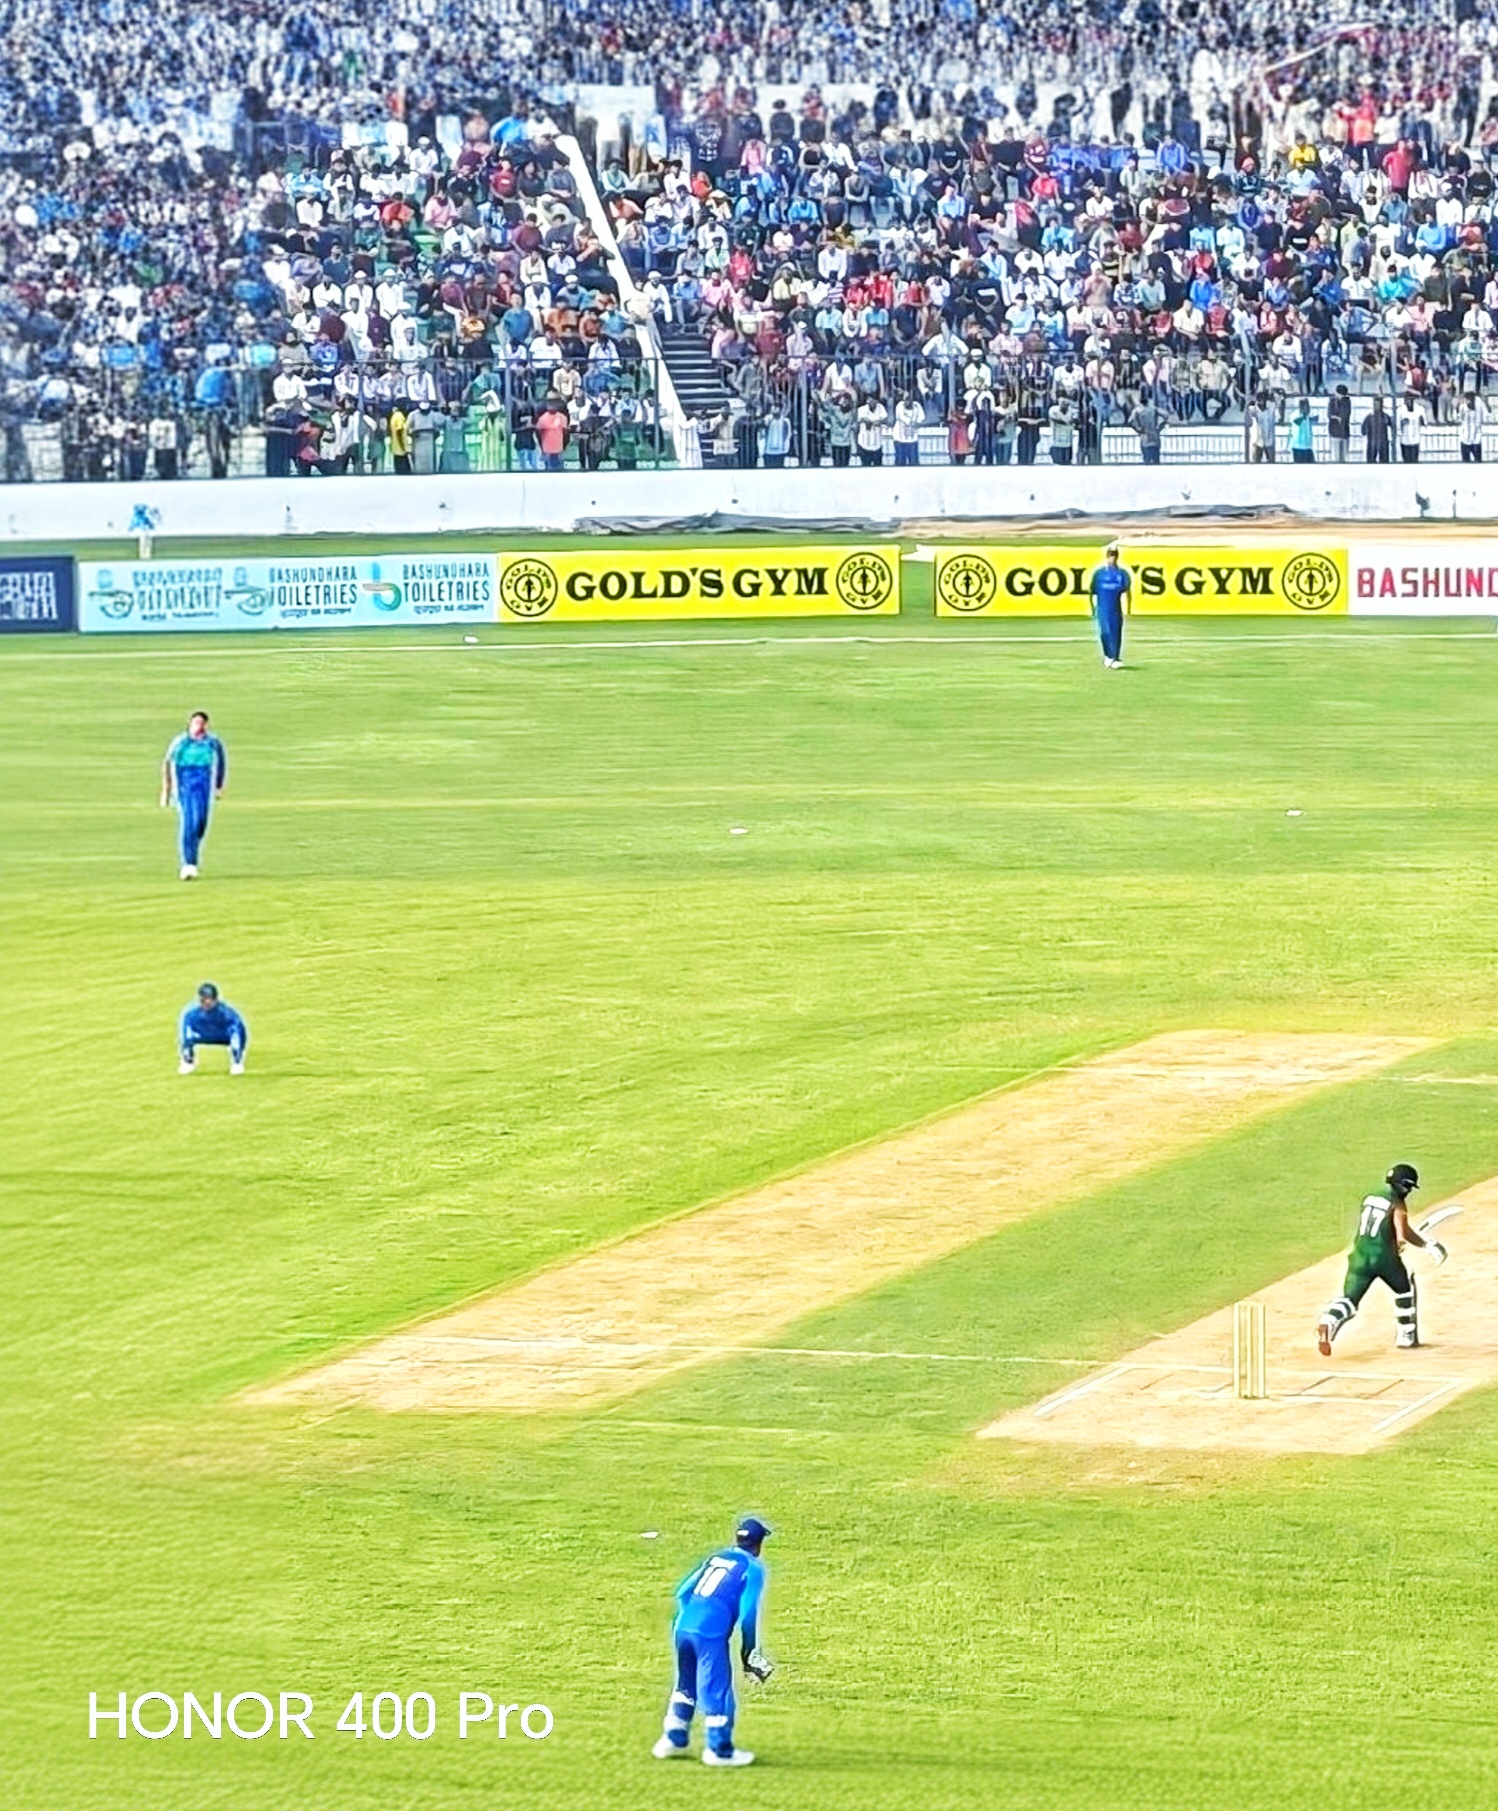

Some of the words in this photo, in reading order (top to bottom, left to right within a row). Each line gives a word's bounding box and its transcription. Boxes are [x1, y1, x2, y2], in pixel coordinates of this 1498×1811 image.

[403, 580, 490, 602] TOILETRIES
[566, 568, 724, 601] GOLD'S
[732, 567, 829, 597] GYM
[1005, 566, 1166, 596] GOL'S
[1174, 567, 1274, 596] GYM
